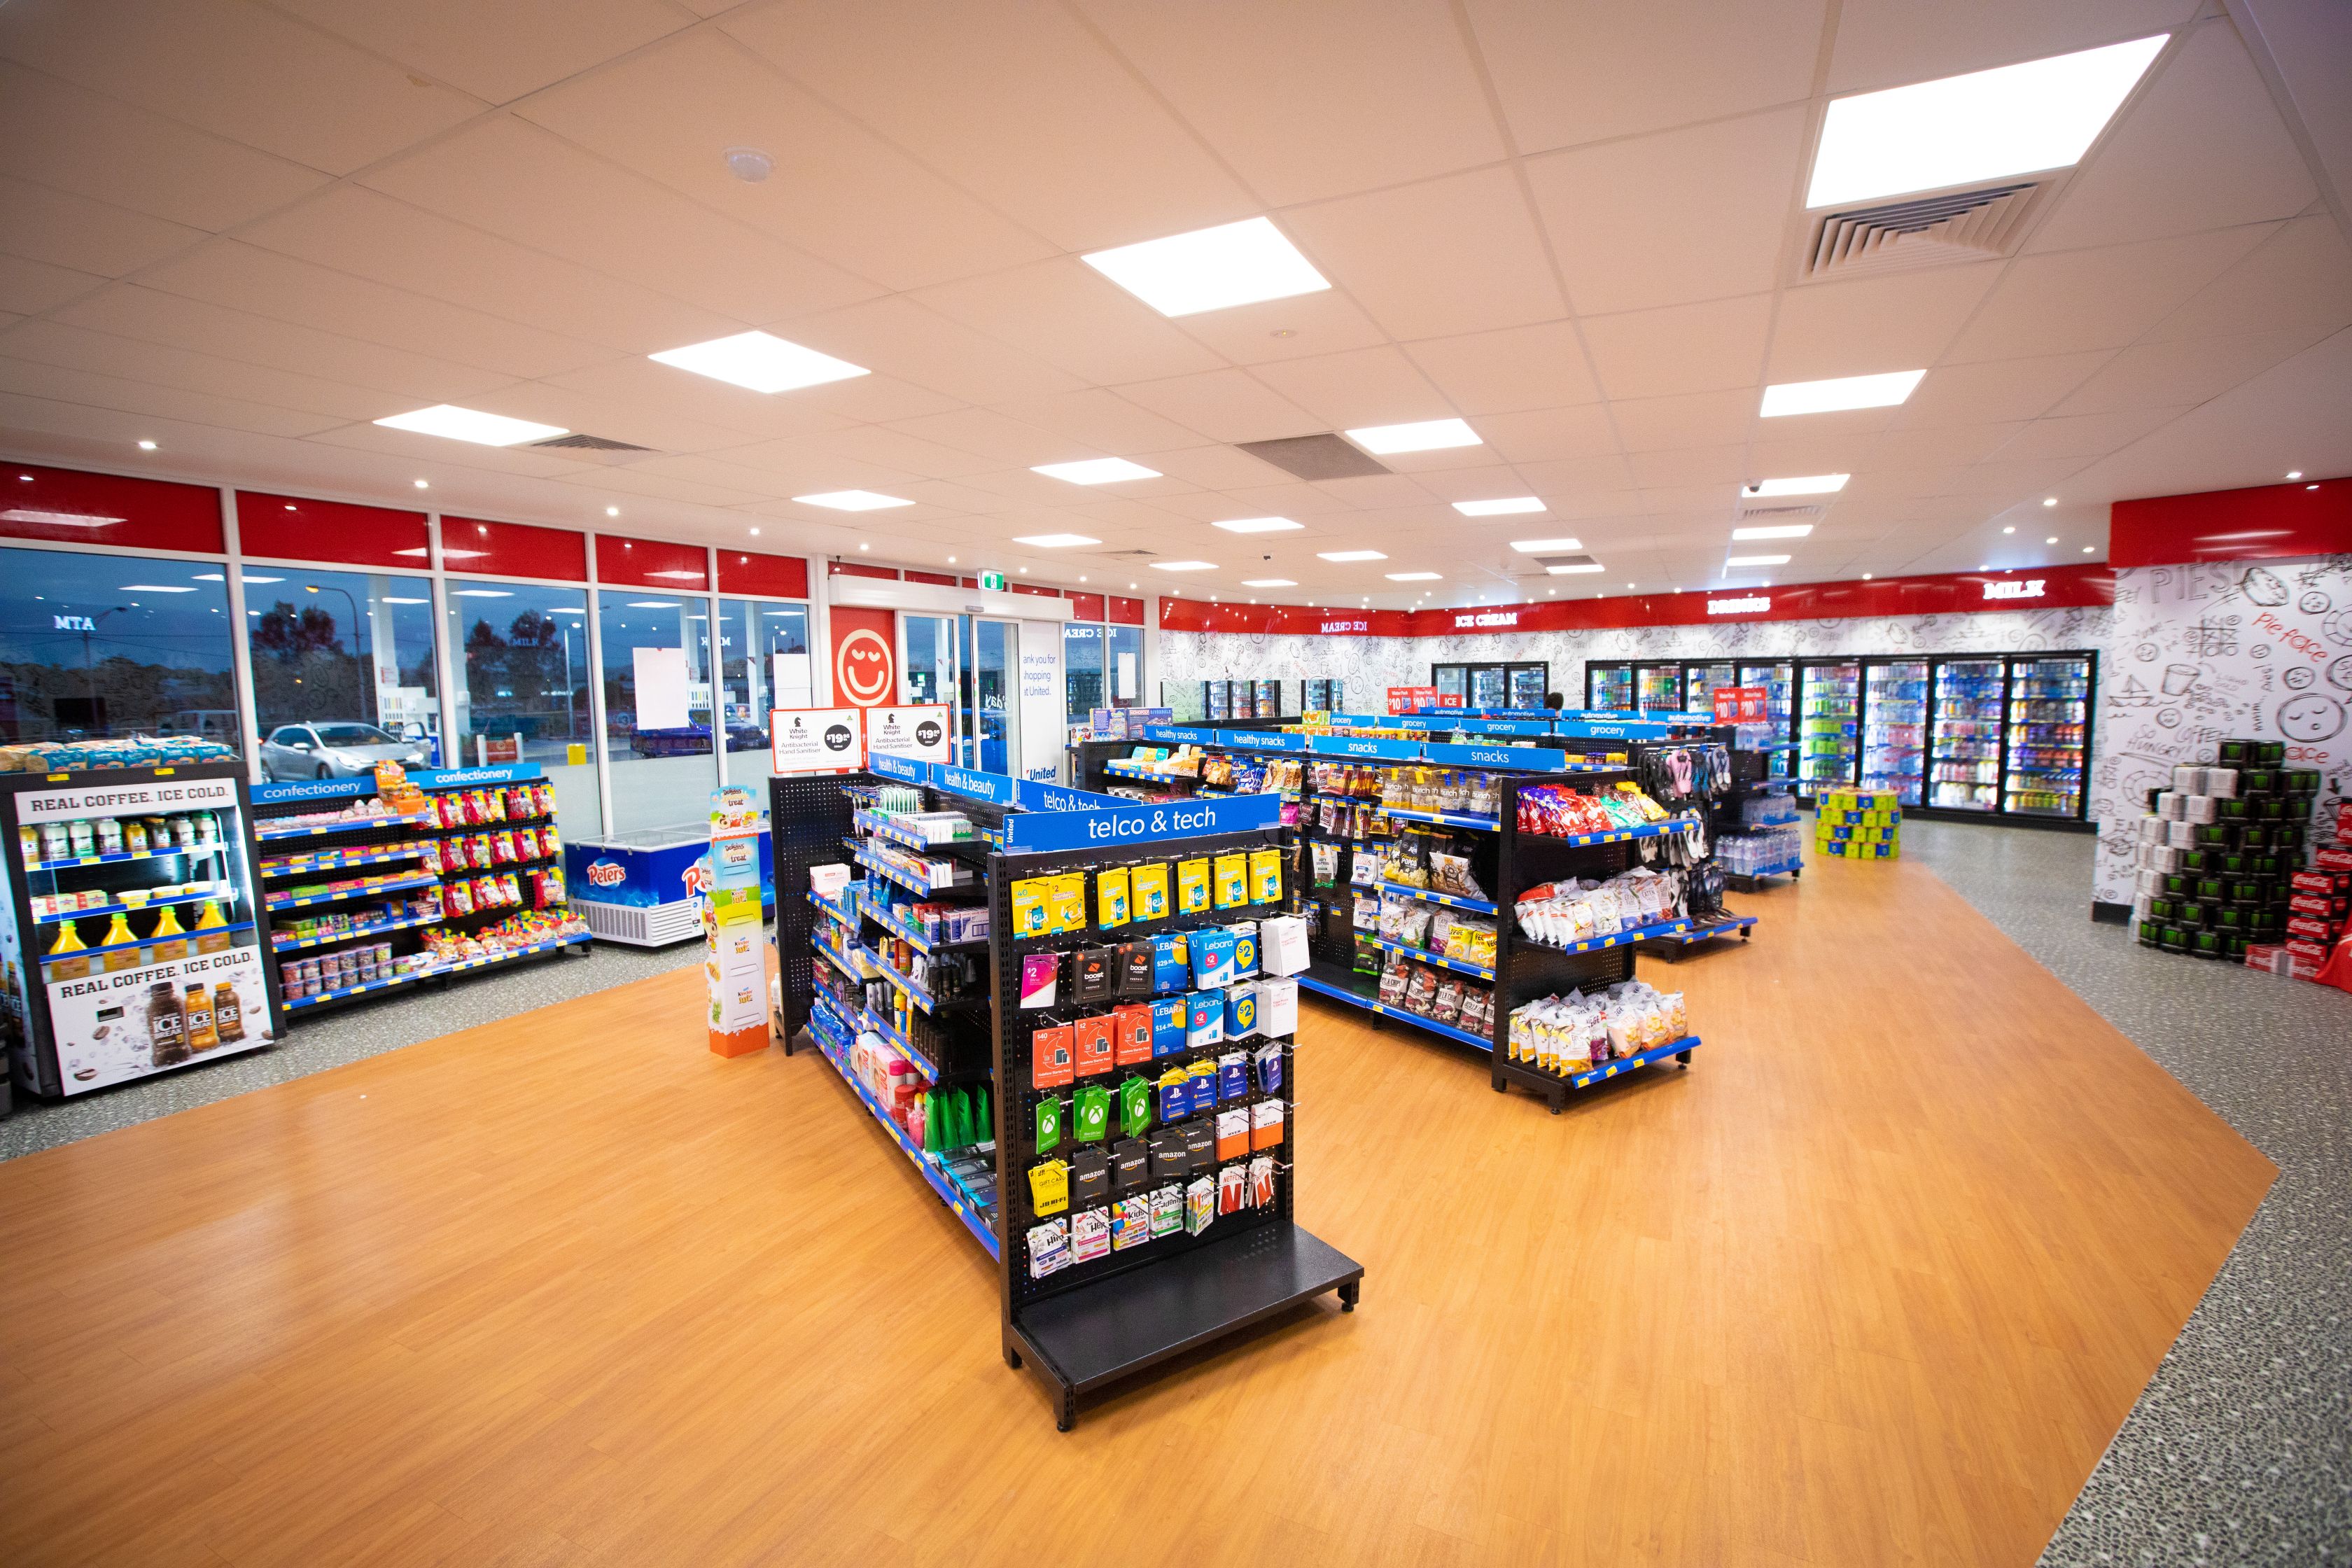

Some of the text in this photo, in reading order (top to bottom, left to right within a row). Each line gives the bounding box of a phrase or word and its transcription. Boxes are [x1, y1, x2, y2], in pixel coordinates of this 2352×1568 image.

[1983, 580, 2045, 599] MILK
[1707, 597, 1770, 615] DRINKS
[1455, 613, 1517, 627] ICE CREAM
[1035, 657, 1046, 666] you
[1024, 671, 1051, 682] hopping
[1030, 687, 1051, 696] United.
[1389, 697, 1401, 710] $10
[1413, 696, 1425, 708] $10
[1445, 698, 1457, 706] ICE
[1716, 702, 1728, 718] $10
[1741, 701, 1754, 716] $10
[1331, 716, 1352, 726] grocery
[1402, 720, 1426, 729] grocery
[1488, 723, 1516, 732] grocery
[1590, 726, 1625, 736] grocery
[1156, 729, 1197, 740] healthy snacks
[1234, 734, 1285, 746] healthy snacks
[1348, 742, 1377, 753] snacks
[1471, 750, 1509, 763] snacks
[879, 757, 916, 780] health & beauty
[1030, 765, 1056, 780] United
[435, 769, 512, 783] confectionery
[945, 769, 995, 799] health & beauty
[263, 783, 361, 799] confectionery
[31, 786, 228, 811] REAL COFFEE. ICE COLD.
[1044, 790, 1065, 811] telco
[1068, 794, 1075, 811] &
[1088, 806, 1216, 839] telco & tech
[587, 864, 626, 885] Peters
[1156, 940, 1184, 951] LEBARA
[1205, 939, 1233, 951] Lebara
[1238, 945, 1251, 958] $2
[1157, 959, 1174, 967] $29.90
[61, 952, 254, 998] REAL COFFEE. ICE COLD.
[1028, 967, 1037, 977] $2
[1155, 1004, 1184, 1016] LEBARA
[1194, 1000, 1222, 1009] Lebara
[1239, 1004, 1252, 1017] $2
[187, 1012, 212, 1025] ICE
[216, 1007, 238, 1019] ICE
[153, 1017, 181, 1032] ICE
[188, 1021, 213, 1030] BREAK
[218, 1016, 239, 1024] BREAK
[155, 1027, 183, 1040] BREAK
[1156, 1023, 1173, 1032] $14.90
[1188, 1140, 1212, 1149] amazon
[1121, 1158, 1144, 1170] amazon
[1079, 1169, 1105, 1181] amazon
[1224, 1174, 1243, 1183] NETFLIX
[1051, 1196, 1066, 1205] HI-FI
[1128, 1210, 1144, 1219] Kids
